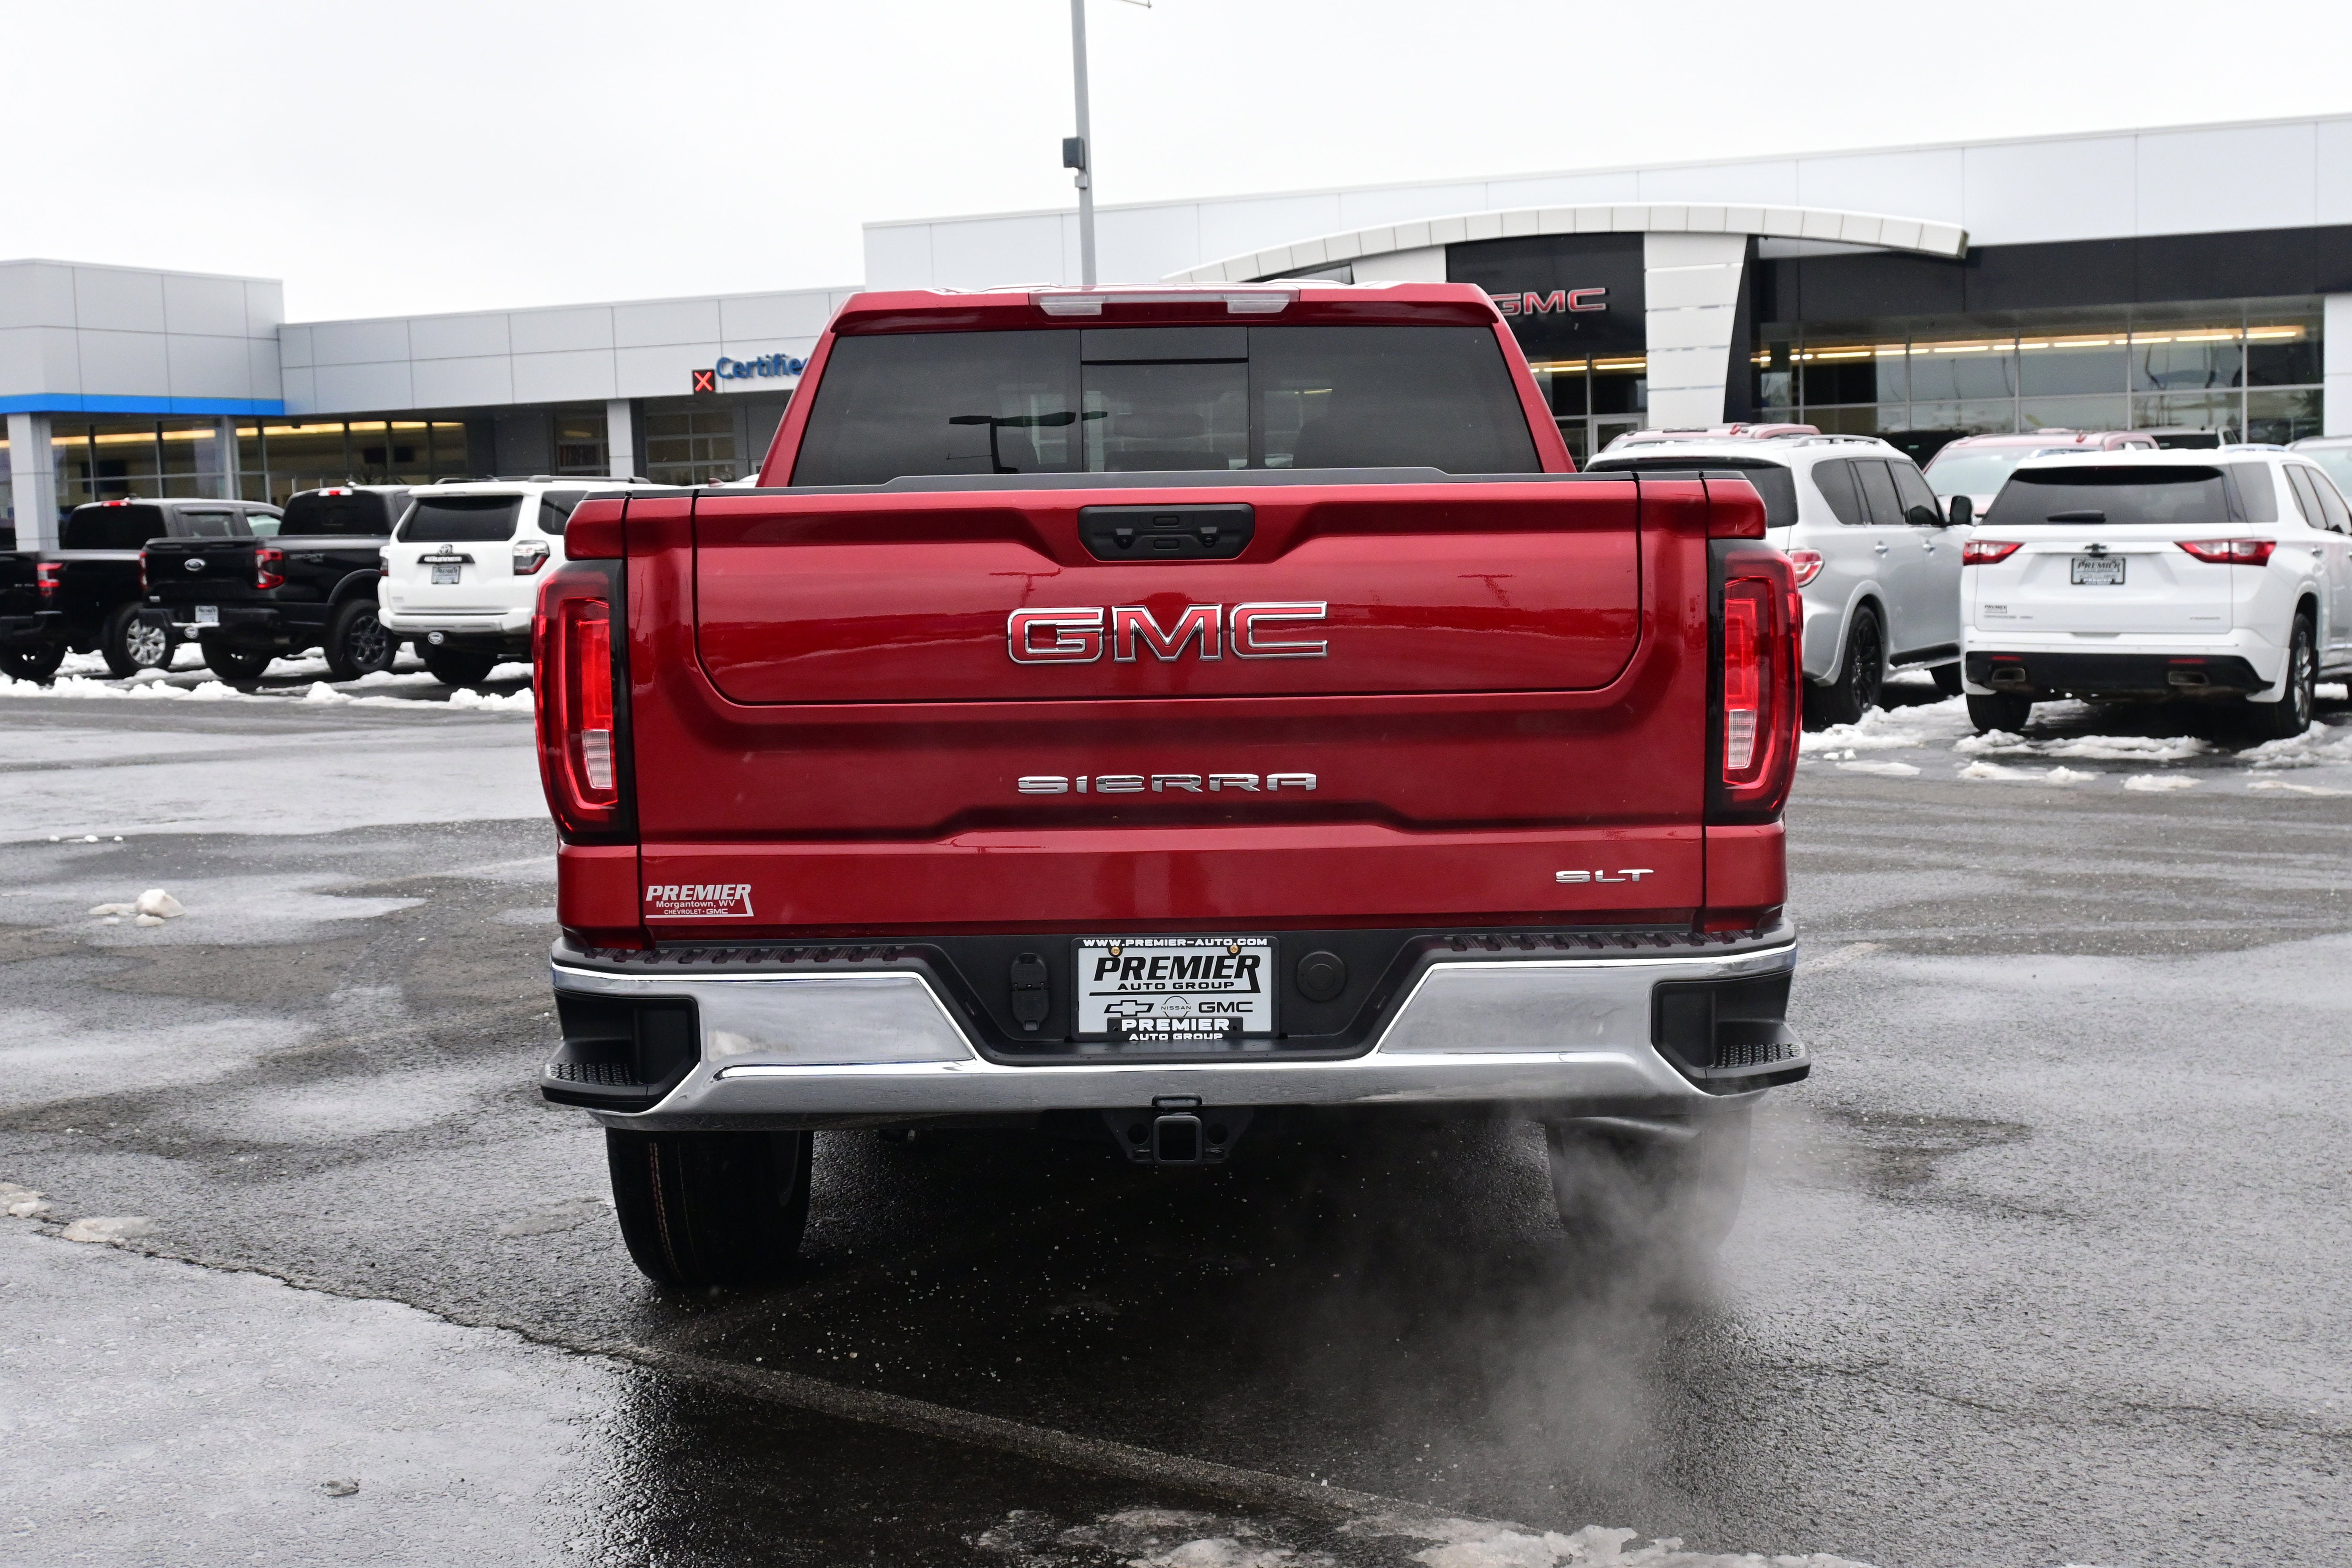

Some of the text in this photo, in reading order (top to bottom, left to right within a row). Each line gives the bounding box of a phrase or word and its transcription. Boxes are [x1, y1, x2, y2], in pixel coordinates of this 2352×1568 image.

[1489, 288, 1606, 316] GMC
[716, 353, 808, 379] Certifie
[1007, 601, 1328, 664] GMC
[1018, 773, 1317, 794] SIERRA
[1556, 869, 1654, 883] SLT
[645, 884, 752, 905] PREMIER
[656, 901, 716, 909] Morgantown,
[1083, 939, 1267, 947] WWW.PREMIER-AUTO.COM
[1094, 955, 1261, 985] PREMIER
[1117, 981, 1234, 991] AUTO GROUP
[1198, 1002, 1253, 1013] GMC
[1122, 1019, 1229, 1031] PREMIER
